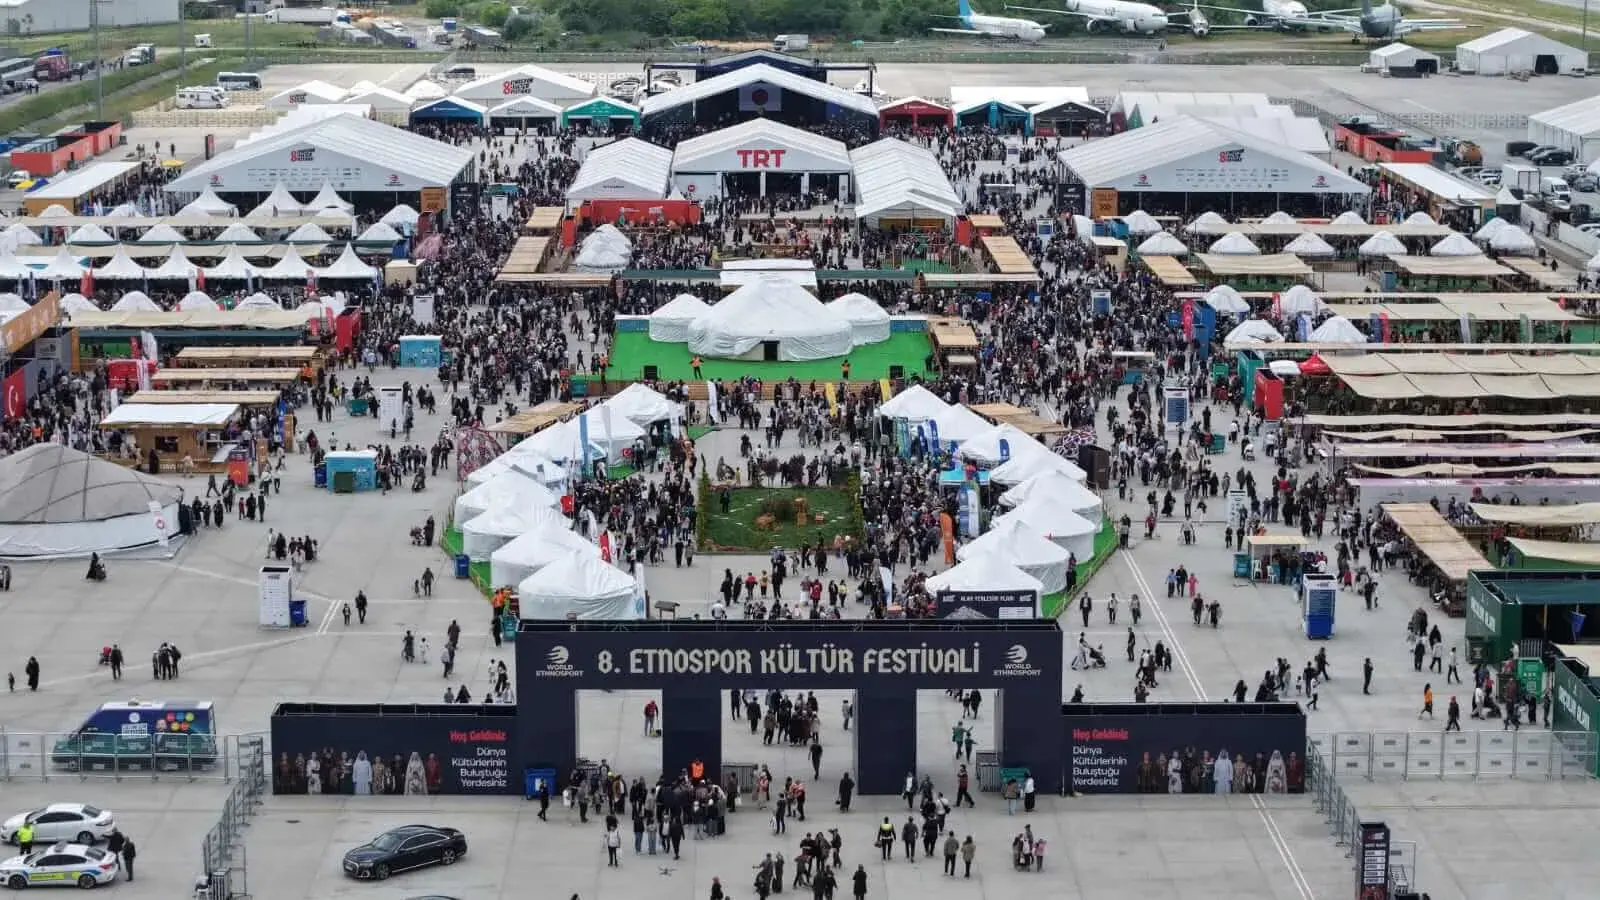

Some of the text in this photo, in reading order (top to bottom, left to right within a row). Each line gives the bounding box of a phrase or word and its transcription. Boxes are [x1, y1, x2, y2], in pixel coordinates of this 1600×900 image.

[737, 149, 786, 168] TRT
[598, 642, 980, 673] 8. ETNOSPOR KÜLTÜR FESTİVALİ
[993, 669, 1041, 677] ETHNOSPORT
[476, 747, 506, 757] Dünya
[1072, 745, 1102, 755] Dünya
[451, 757, 507, 767] Kültürlerinin
[1072, 756, 1127, 766] Kültürlerinin
[460, 768, 507, 778] Buluştuğu
[1072, 767, 1120, 777] Buluştuğu
[461, 778, 507, 787] Yerdesiniz
[1072, 776, 1119, 786] Yerdesiniz
